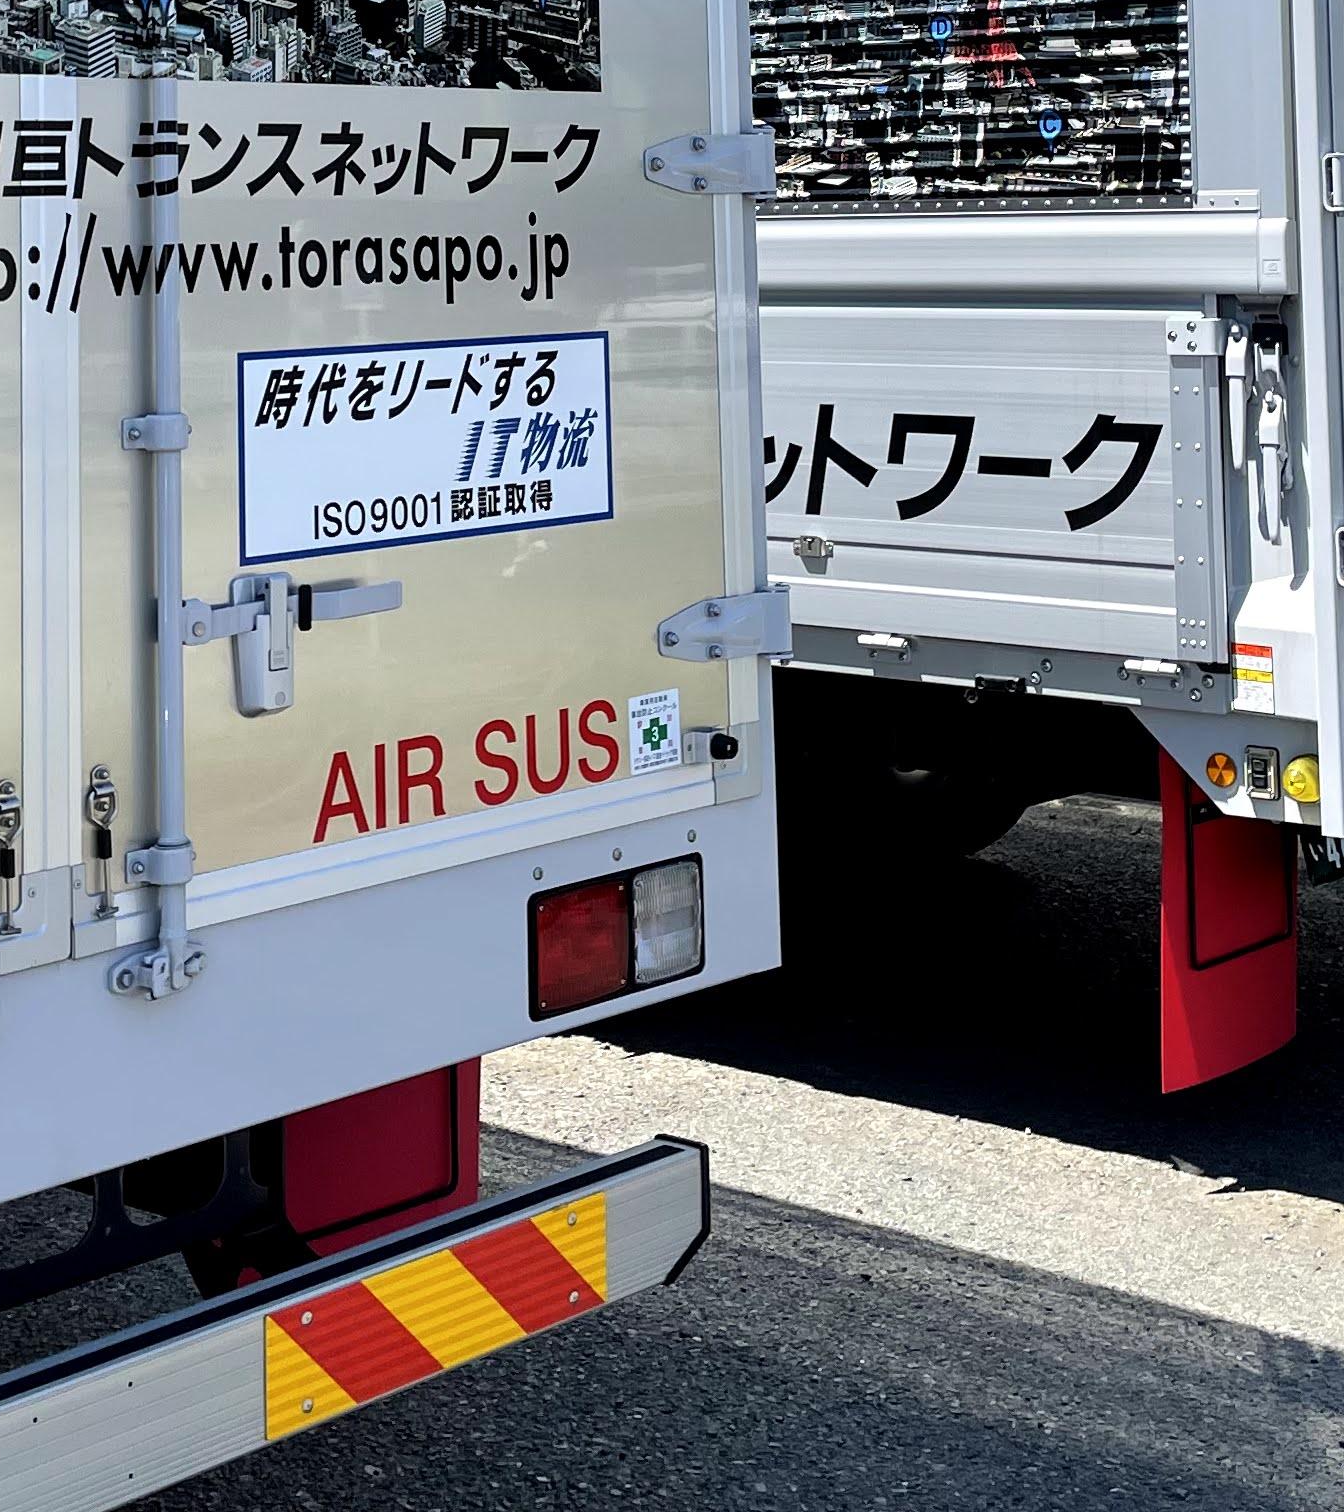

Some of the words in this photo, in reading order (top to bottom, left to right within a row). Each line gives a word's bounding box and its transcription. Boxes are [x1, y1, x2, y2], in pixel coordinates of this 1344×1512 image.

[936, 19, 948, 35] D
[255, 350, 558, 429] 時代をリードする
[453, 408, 598, 481] IT物流
[313, 479, 554, 540] ISO9001認証取得
[651, 726, 659, 742] 3
[312, 734, 447, 844] AIR
[473, 699, 620, 806] SUS
